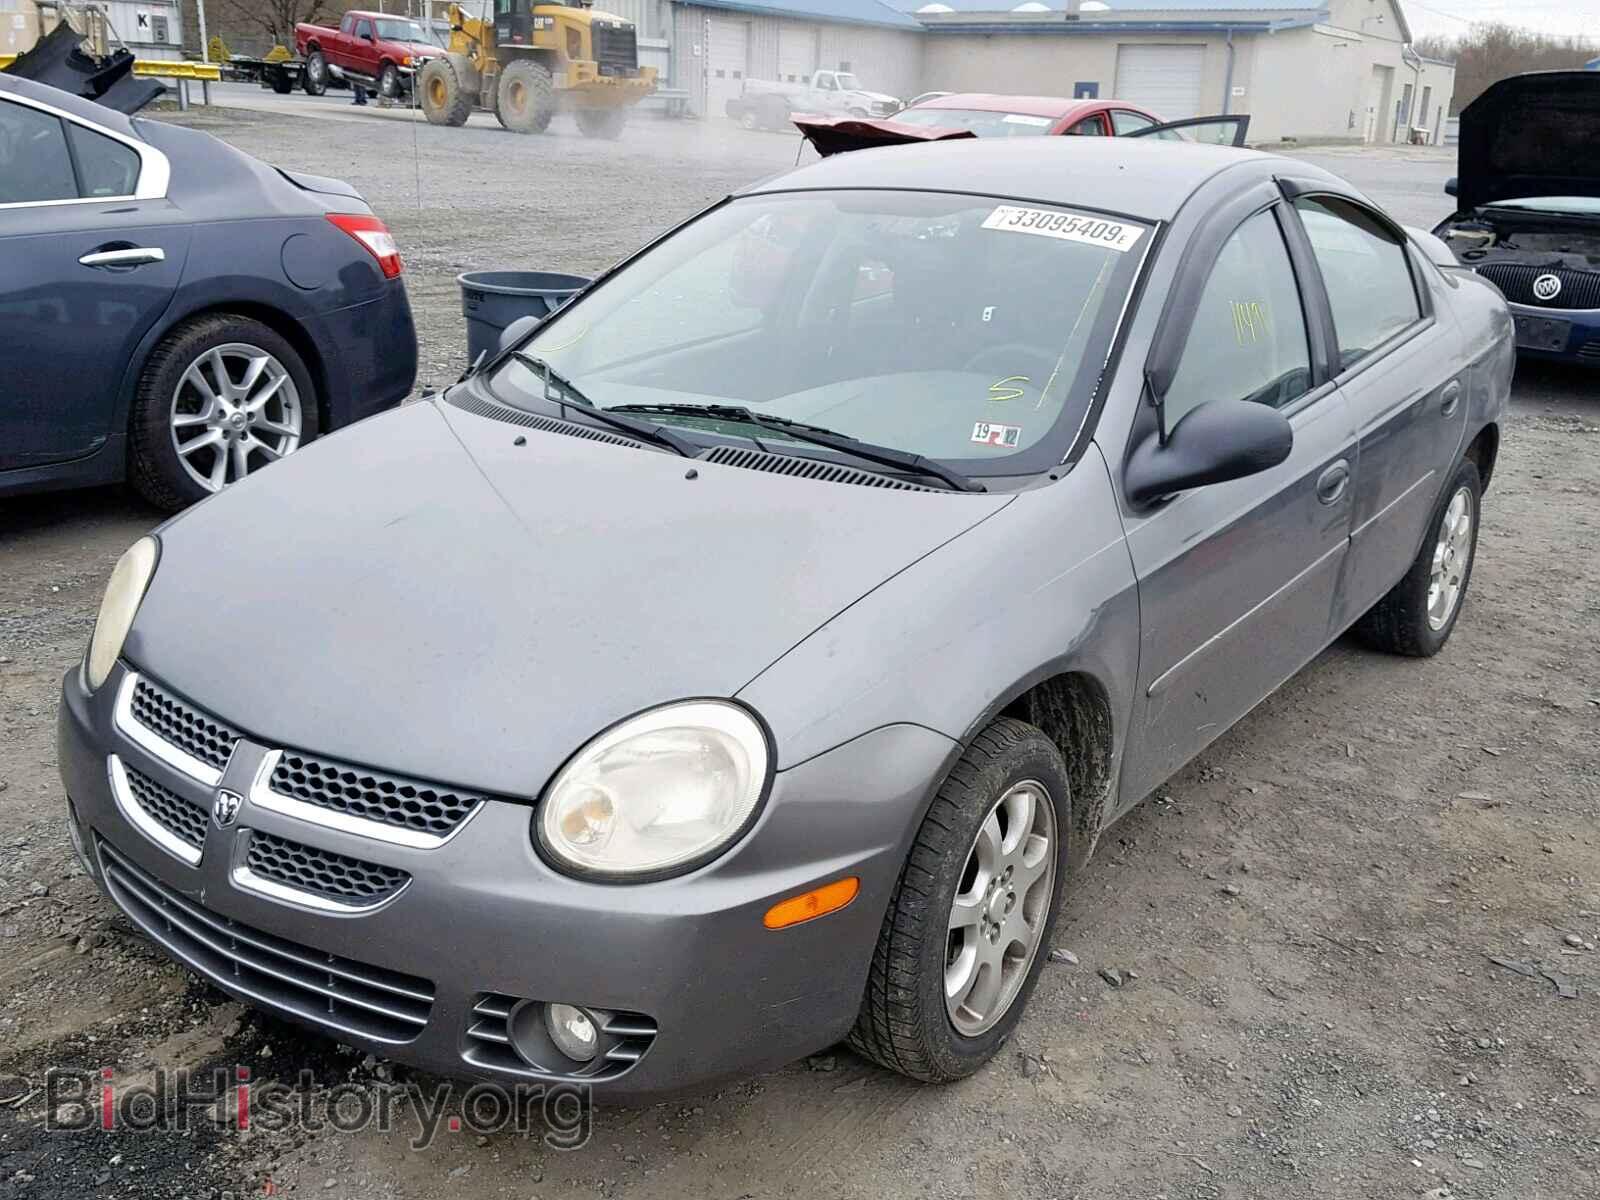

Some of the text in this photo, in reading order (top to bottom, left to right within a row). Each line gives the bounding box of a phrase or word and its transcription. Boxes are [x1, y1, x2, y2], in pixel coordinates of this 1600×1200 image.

[137, 14, 148, 27] K
[1009, 210, 1122, 242] 33095409
[975, 423, 990, 439] 19
